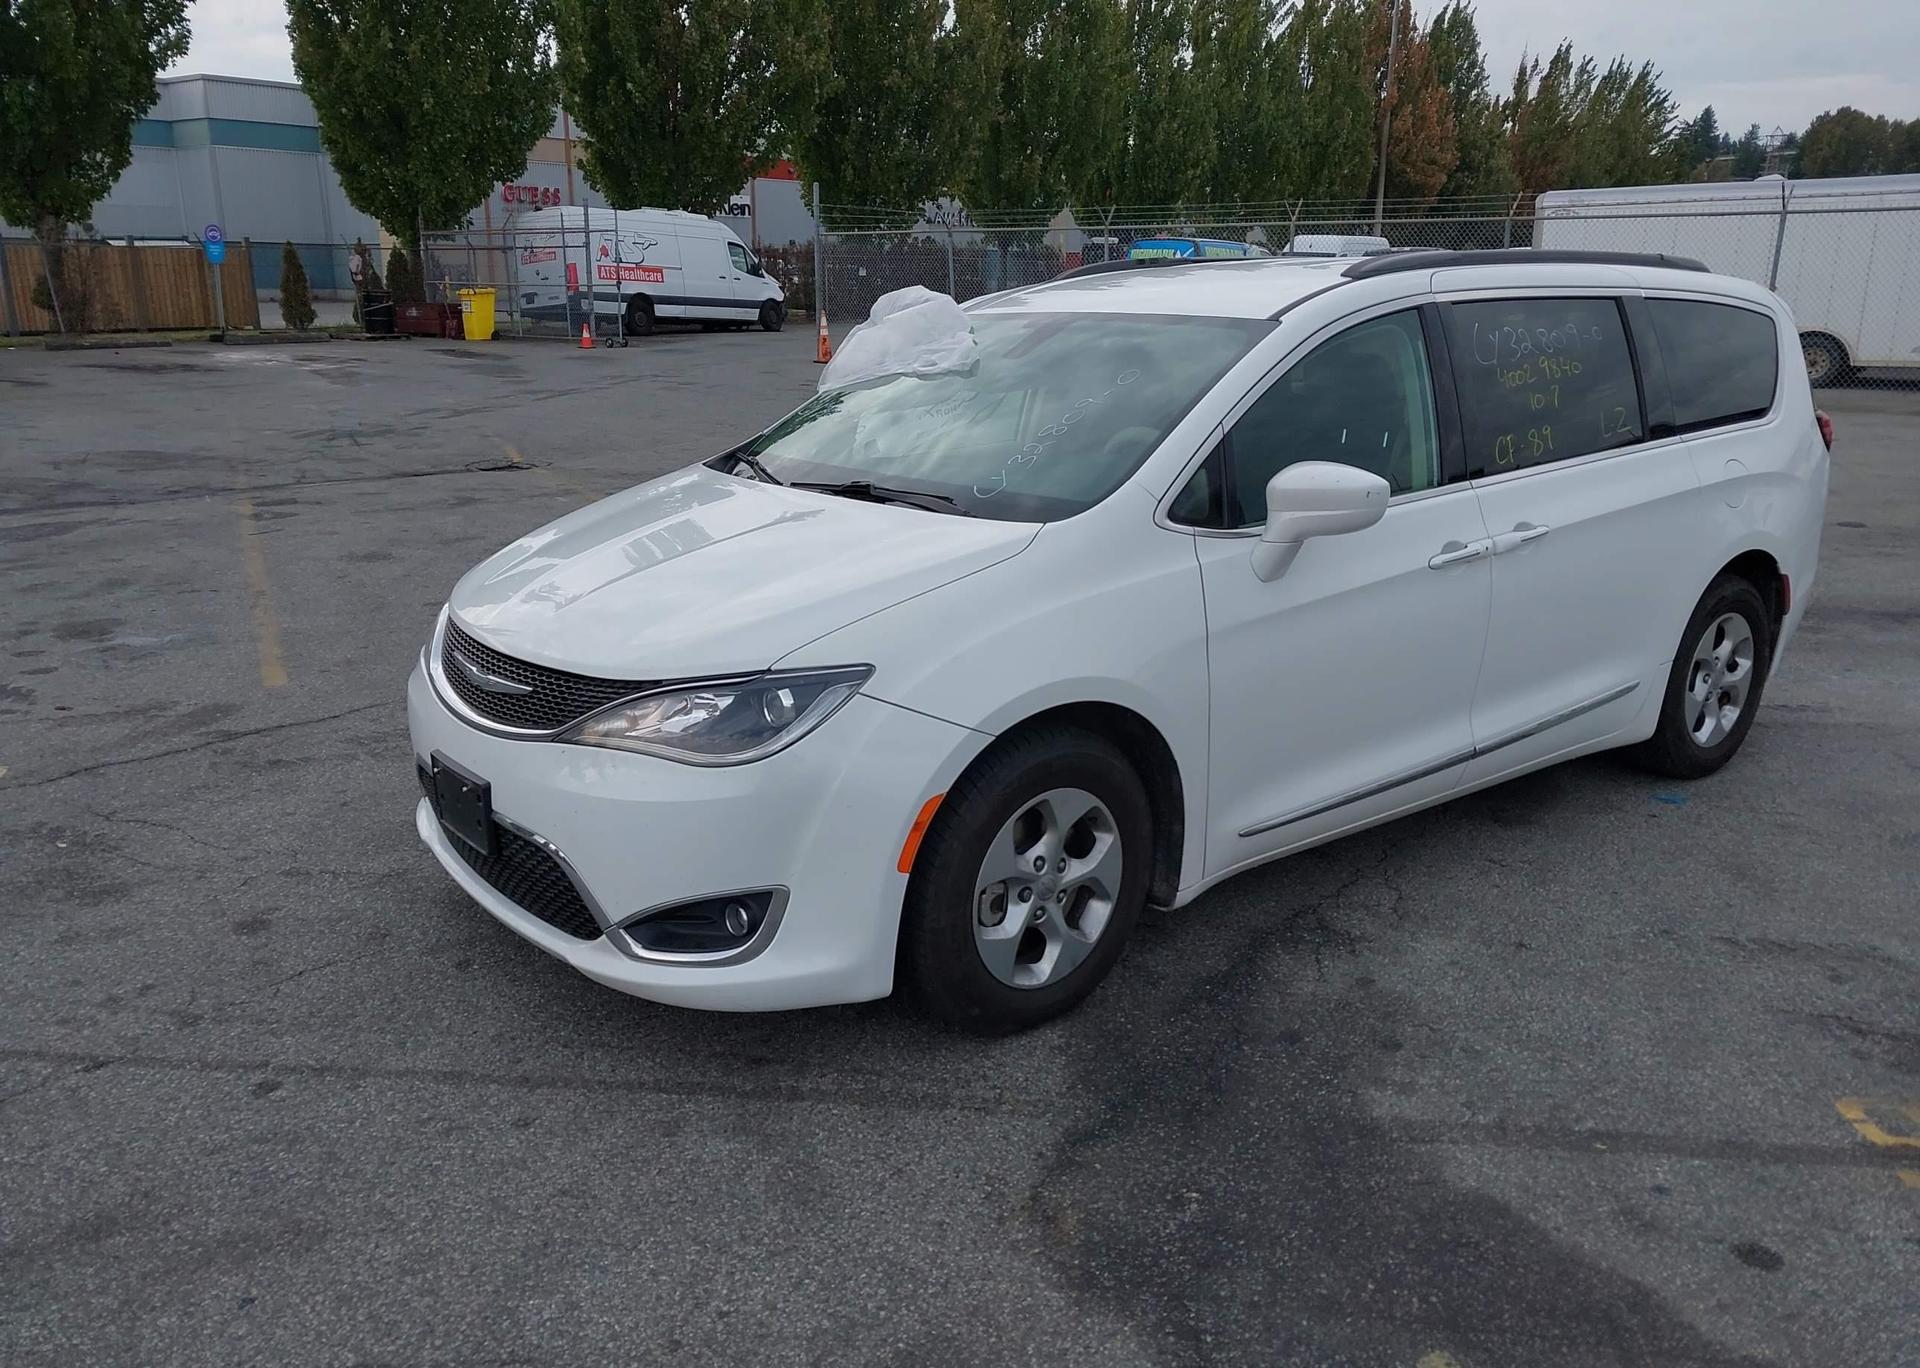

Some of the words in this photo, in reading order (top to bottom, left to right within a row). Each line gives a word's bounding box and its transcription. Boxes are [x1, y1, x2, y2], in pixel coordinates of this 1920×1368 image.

[502, 184, 561, 205] GUESS
[600, 266, 616, 279] ATS
[618, 267, 662, 282] Healthcare
